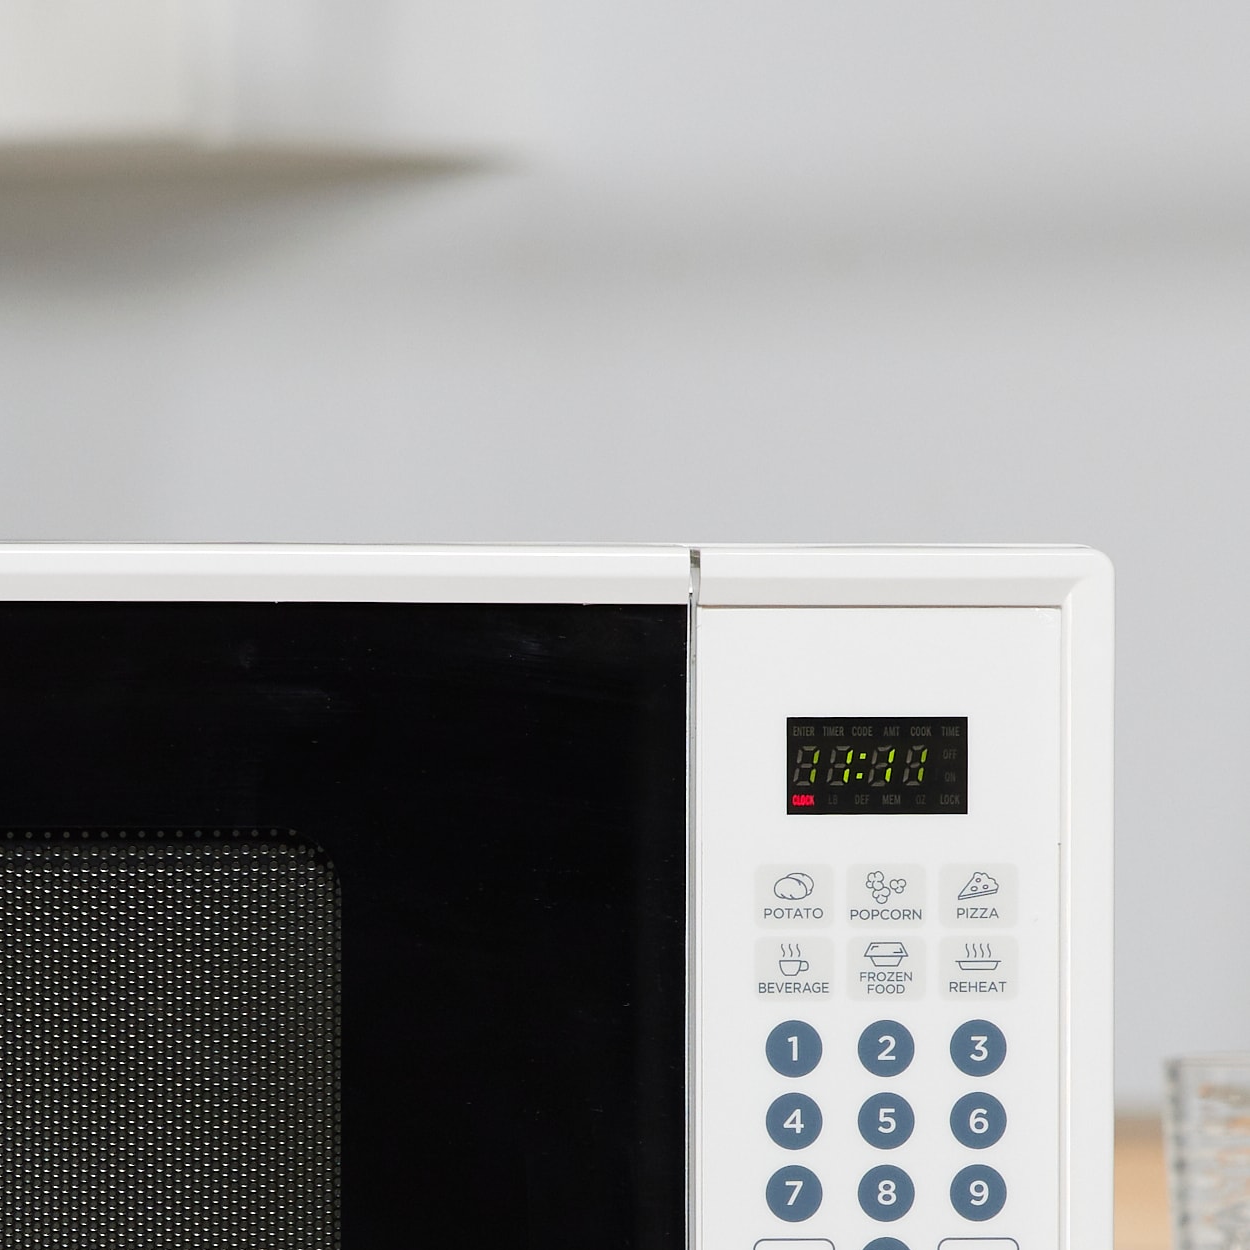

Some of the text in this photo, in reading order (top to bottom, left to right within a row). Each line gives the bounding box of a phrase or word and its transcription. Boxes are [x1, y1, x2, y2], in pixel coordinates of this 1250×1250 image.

[793, 726, 815, 736] ENTER
[823, 726, 844, 736] TIMER
[852, 726, 873, 736] CODE
[884, 726, 899, 736] AMT
[911, 726, 931, 736] COOK
[942, 726, 959, 736] TIME
[792, 795, 814, 805] CLOCK
[855, 795, 870, 804] DEF
[882, 795, 900, 804] MEM
[940, 795, 959, 804] LOCK
[764, 908, 823, 919] POTATO
[850, 909, 922, 920] POPCORN
[957, 908, 999, 919] PIZZA
[860, 972, 912, 982] FROZEN
[758, 982, 829, 993] BEVERAGE
[867, 984, 905, 994] FOOD
[949, 981, 1007, 992] REHEAT
[788, 1036, 799, 1061] 1
[877, 1036, 896, 1060] 2
[969, 1036, 988, 1061] 3
[783, 1109, 804, 1134] 4
[878, 1108, 896, 1133] 5
[969, 1108, 989, 1134] 6
[785, 1181, 803, 1206] 7
[877, 1180, 896, 1206] 8
[969, 1181, 989, 1206] 9
